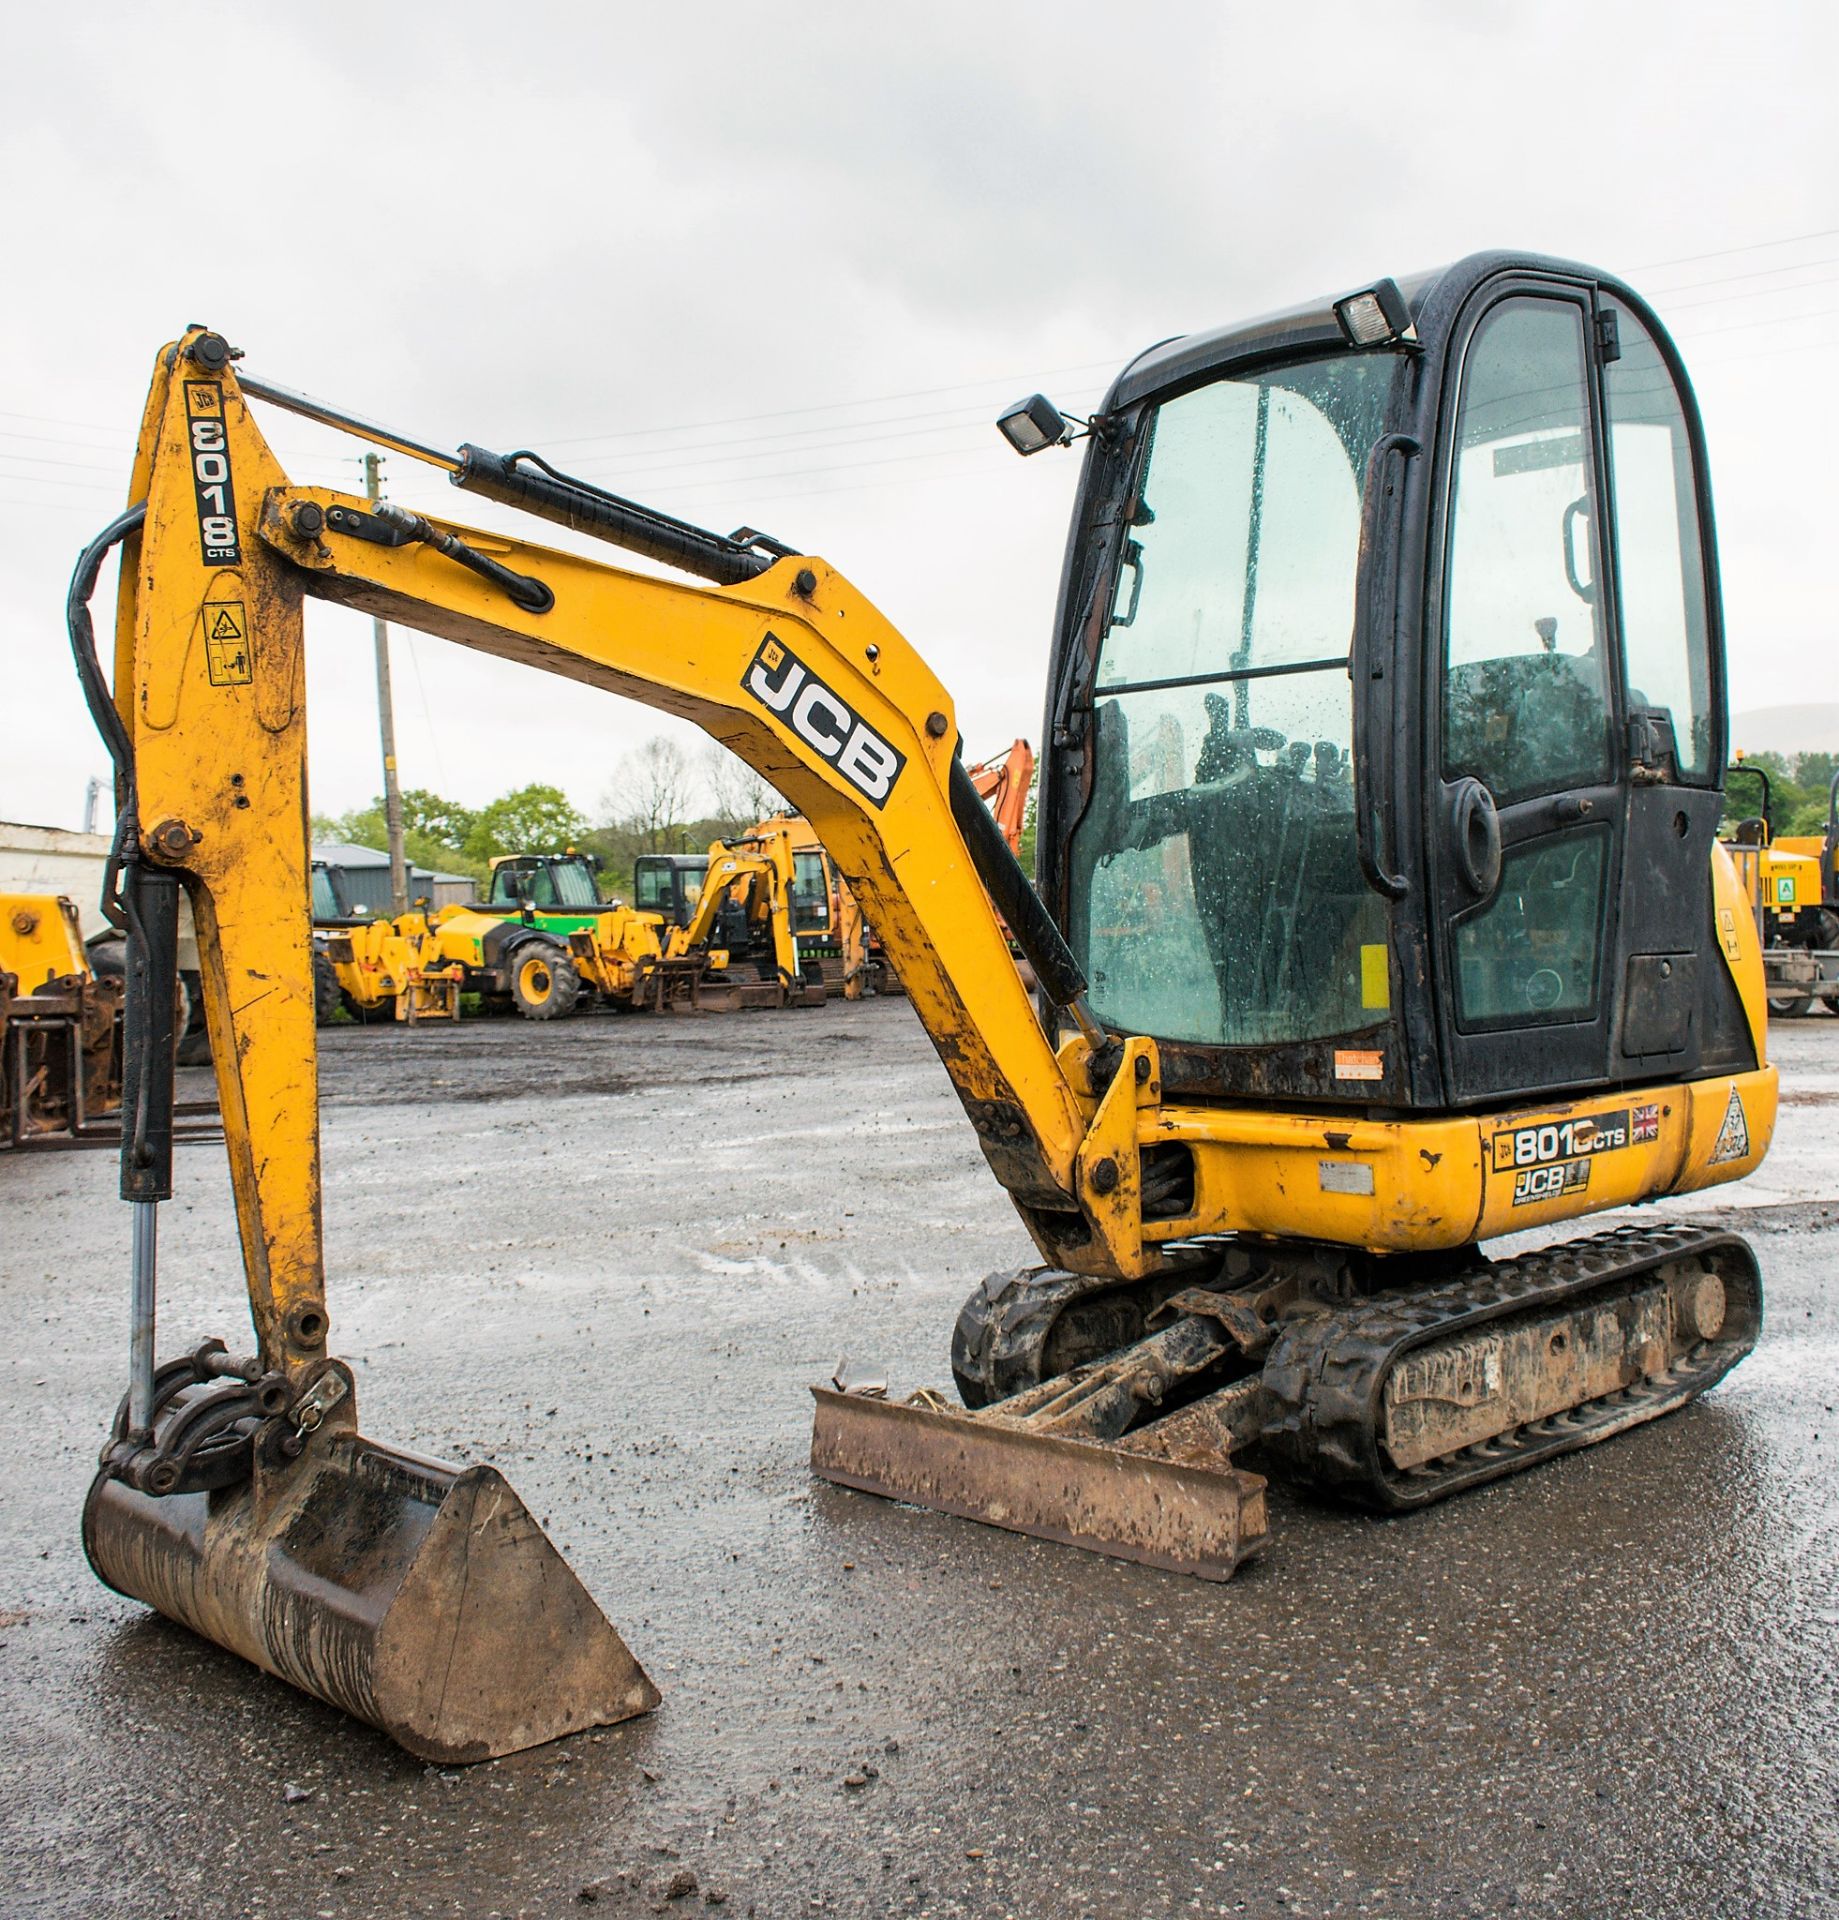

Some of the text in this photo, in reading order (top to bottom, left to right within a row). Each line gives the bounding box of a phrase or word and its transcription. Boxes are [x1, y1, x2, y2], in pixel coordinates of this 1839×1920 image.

[195, 392, 215, 408] JCB
[191, 421, 236, 547] 8018
[206, 547, 236, 558] CTS
[750, 662, 898, 800] JCB
[1593, 1128, 1626, 1150] CTS
[1515, 1165, 1565, 1197] JCB
